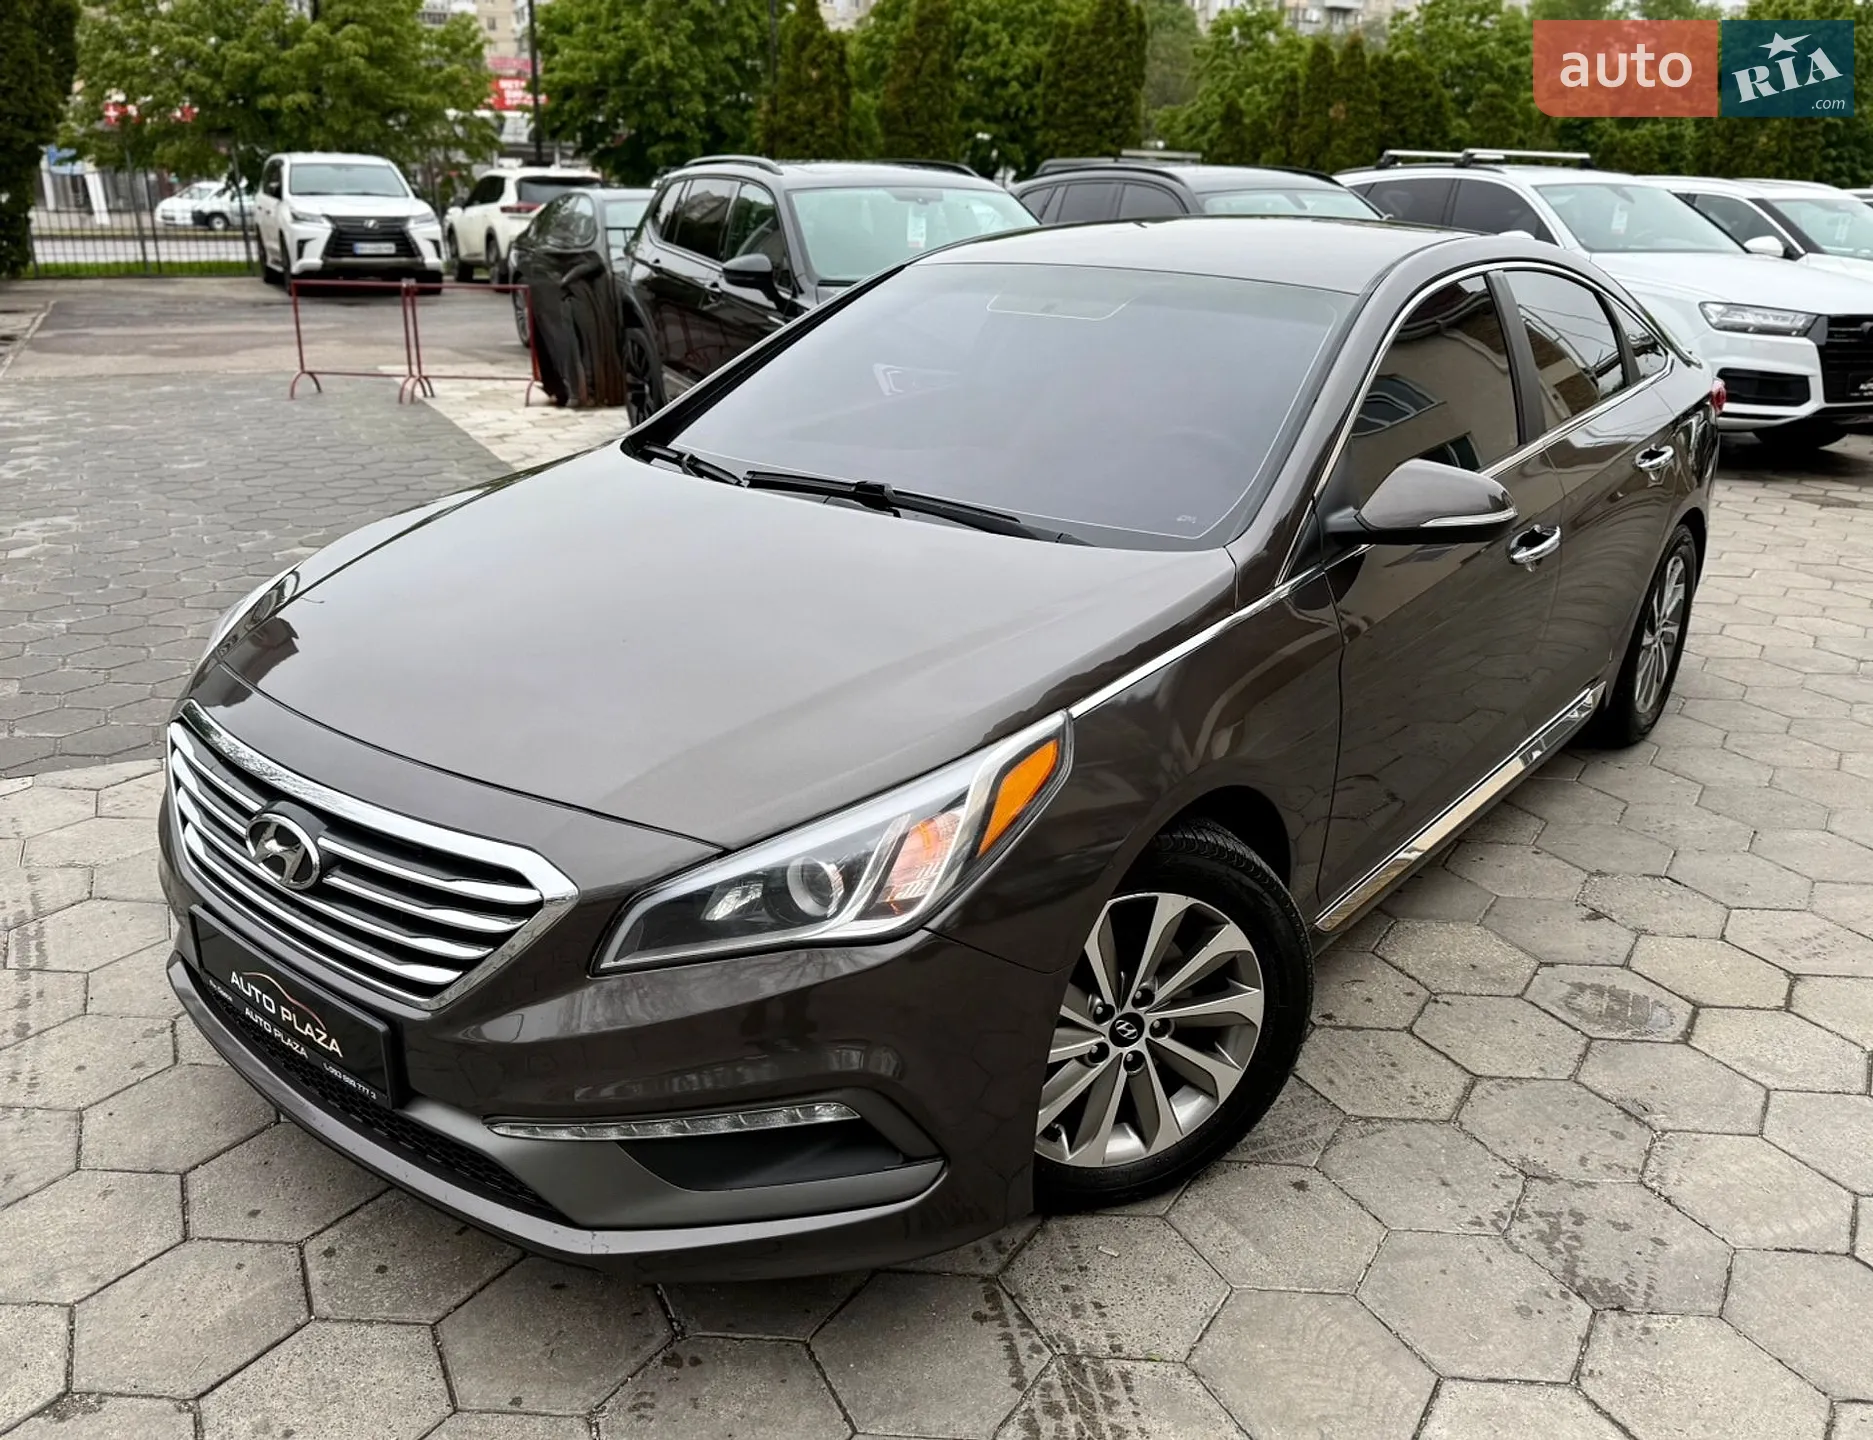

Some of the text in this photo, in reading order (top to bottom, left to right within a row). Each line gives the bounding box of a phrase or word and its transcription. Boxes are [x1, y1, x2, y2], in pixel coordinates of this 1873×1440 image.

[231, 971, 276, 1014] AUTO
[280, 1005, 343, 1058] PLAZA
[245, 1007, 309, 1060] AUTO PLAZA
